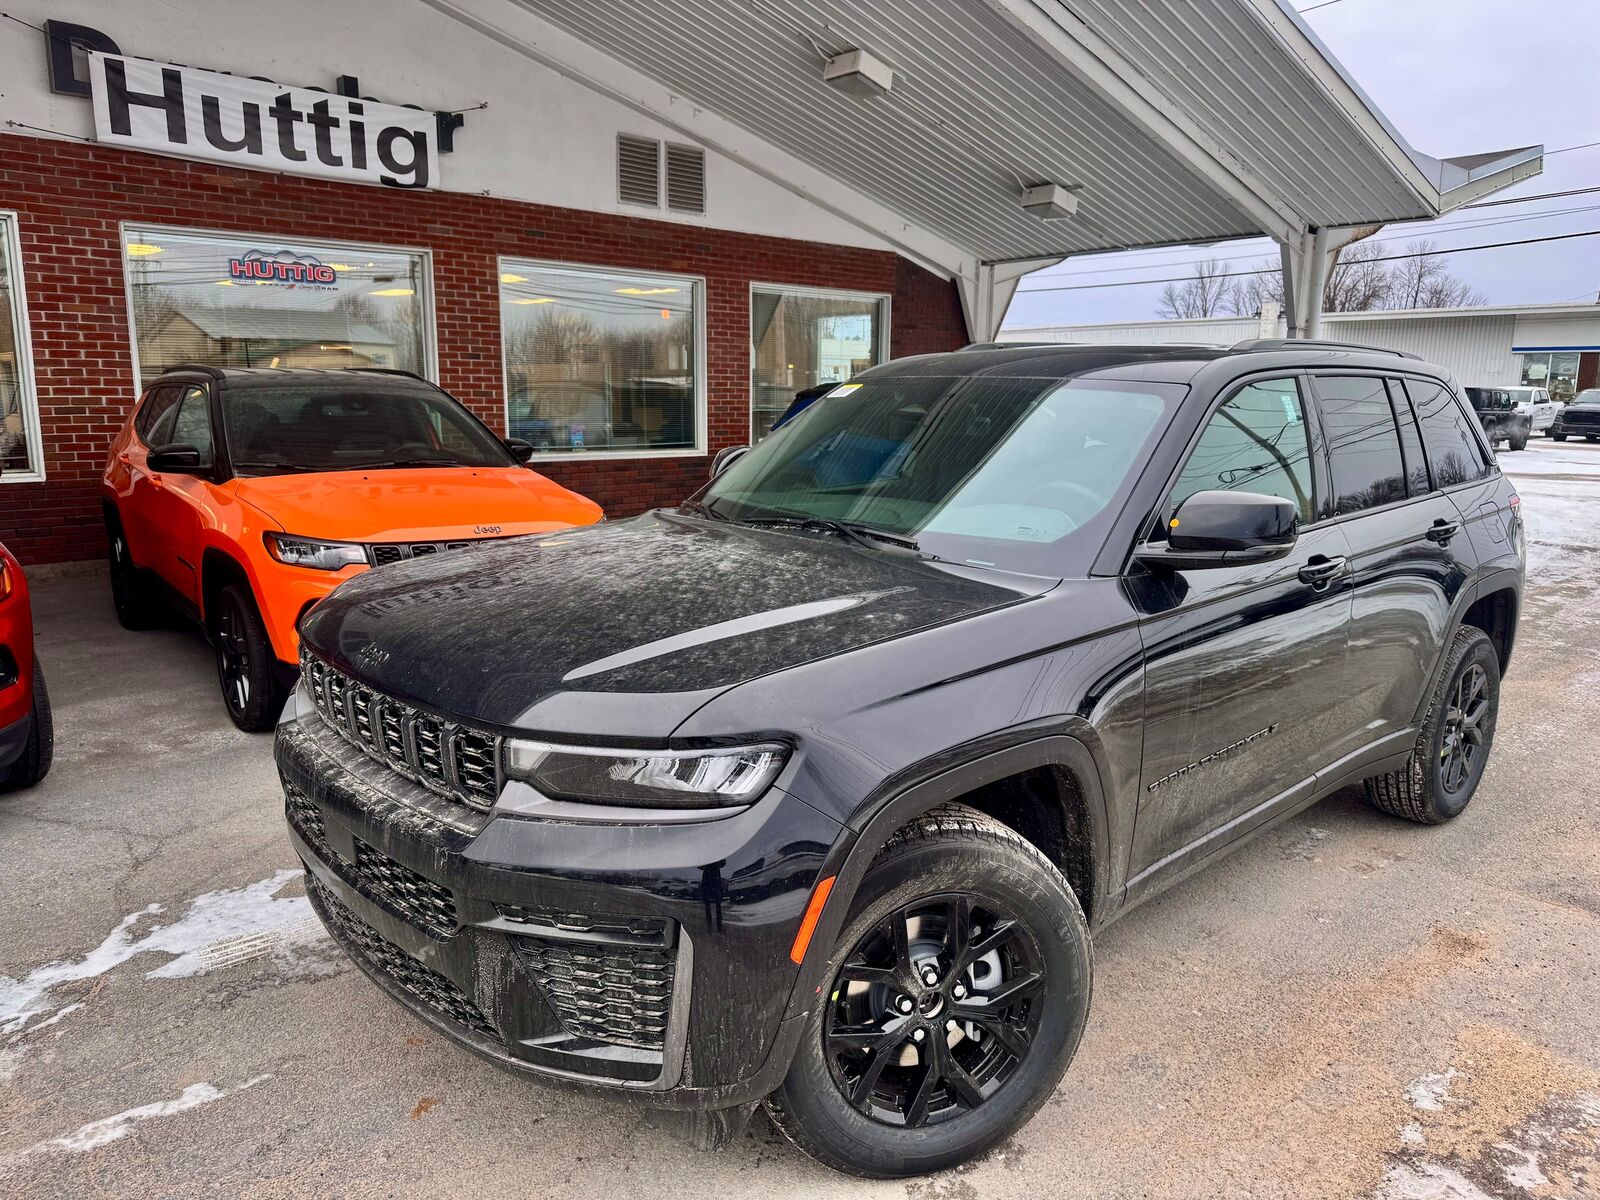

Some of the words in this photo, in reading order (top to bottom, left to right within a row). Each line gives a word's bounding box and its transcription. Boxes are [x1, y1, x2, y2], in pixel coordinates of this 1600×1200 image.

[103, 57, 430, 188] Huttig
[230, 259, 336, 283] HUTTIG
[473, 525, 502, 534] Jeep
